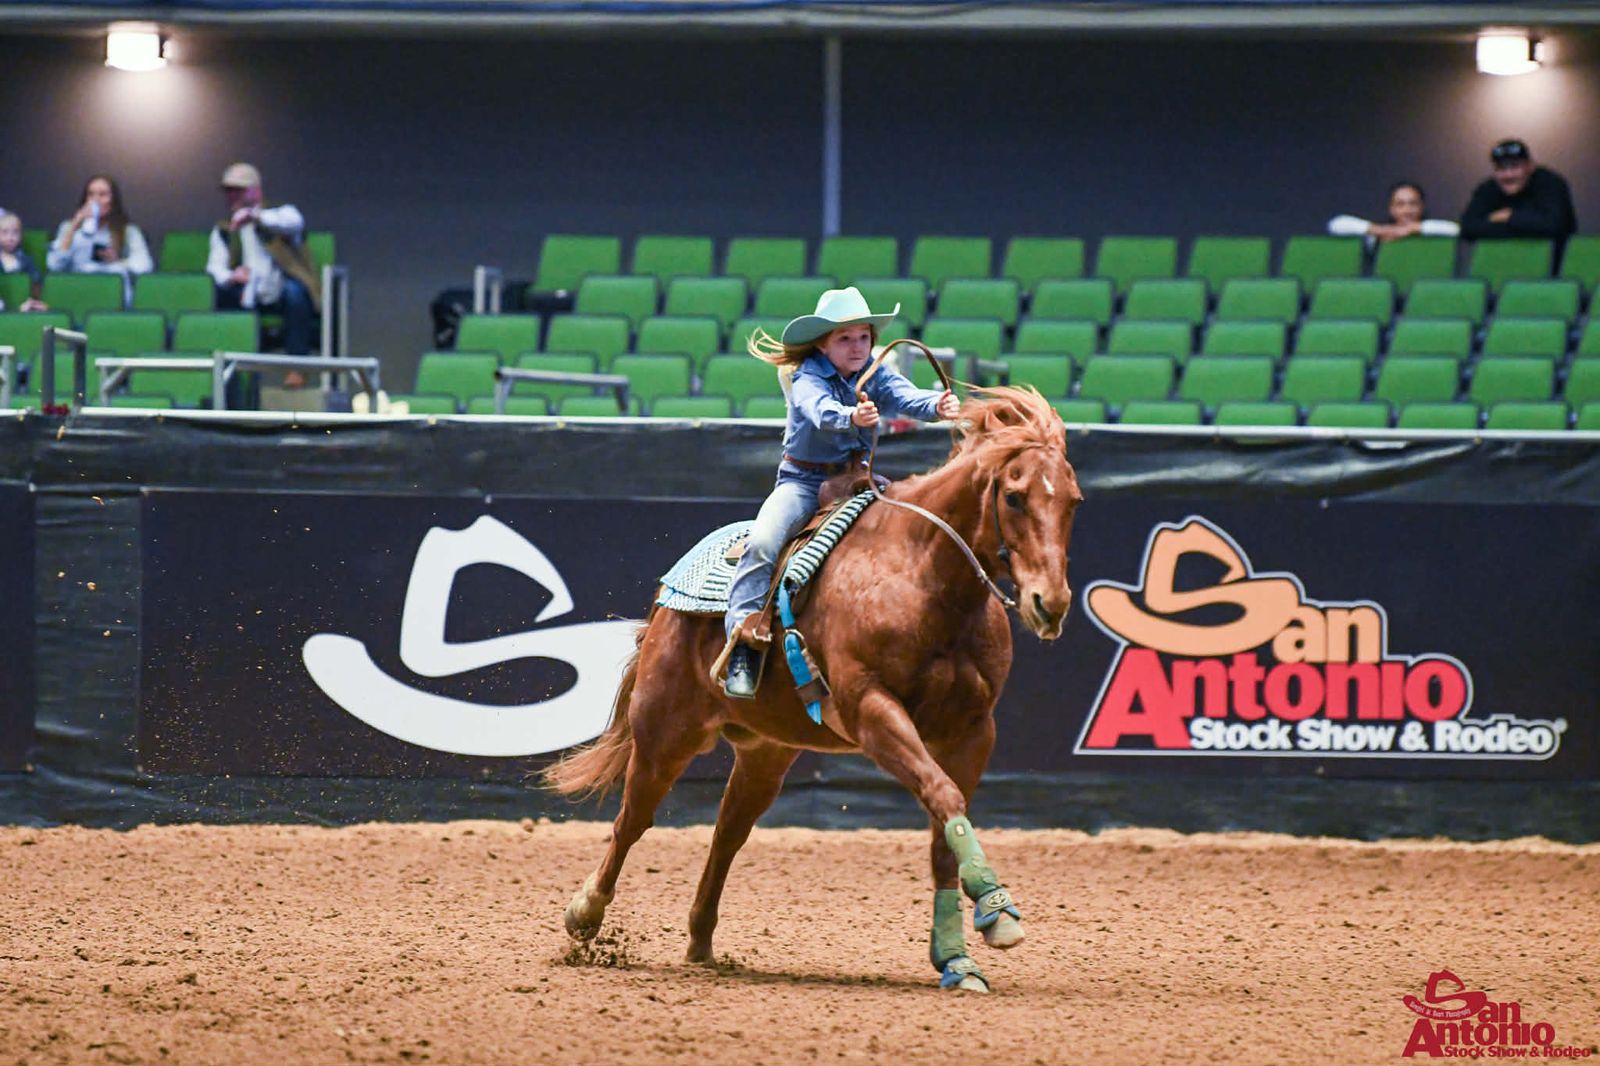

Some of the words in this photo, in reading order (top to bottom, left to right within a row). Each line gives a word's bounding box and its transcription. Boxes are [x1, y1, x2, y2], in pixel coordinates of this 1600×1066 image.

[1088, 518, 1382, 663] San
[1085, 648, 1468, 749] Antonio
[1190, 717, 1291, 750] Stock
[1299, 719, 1396, 750] Show
[1400, 721, 1429, 751] &
[1435, 720, 1553, 753] Rodeo
